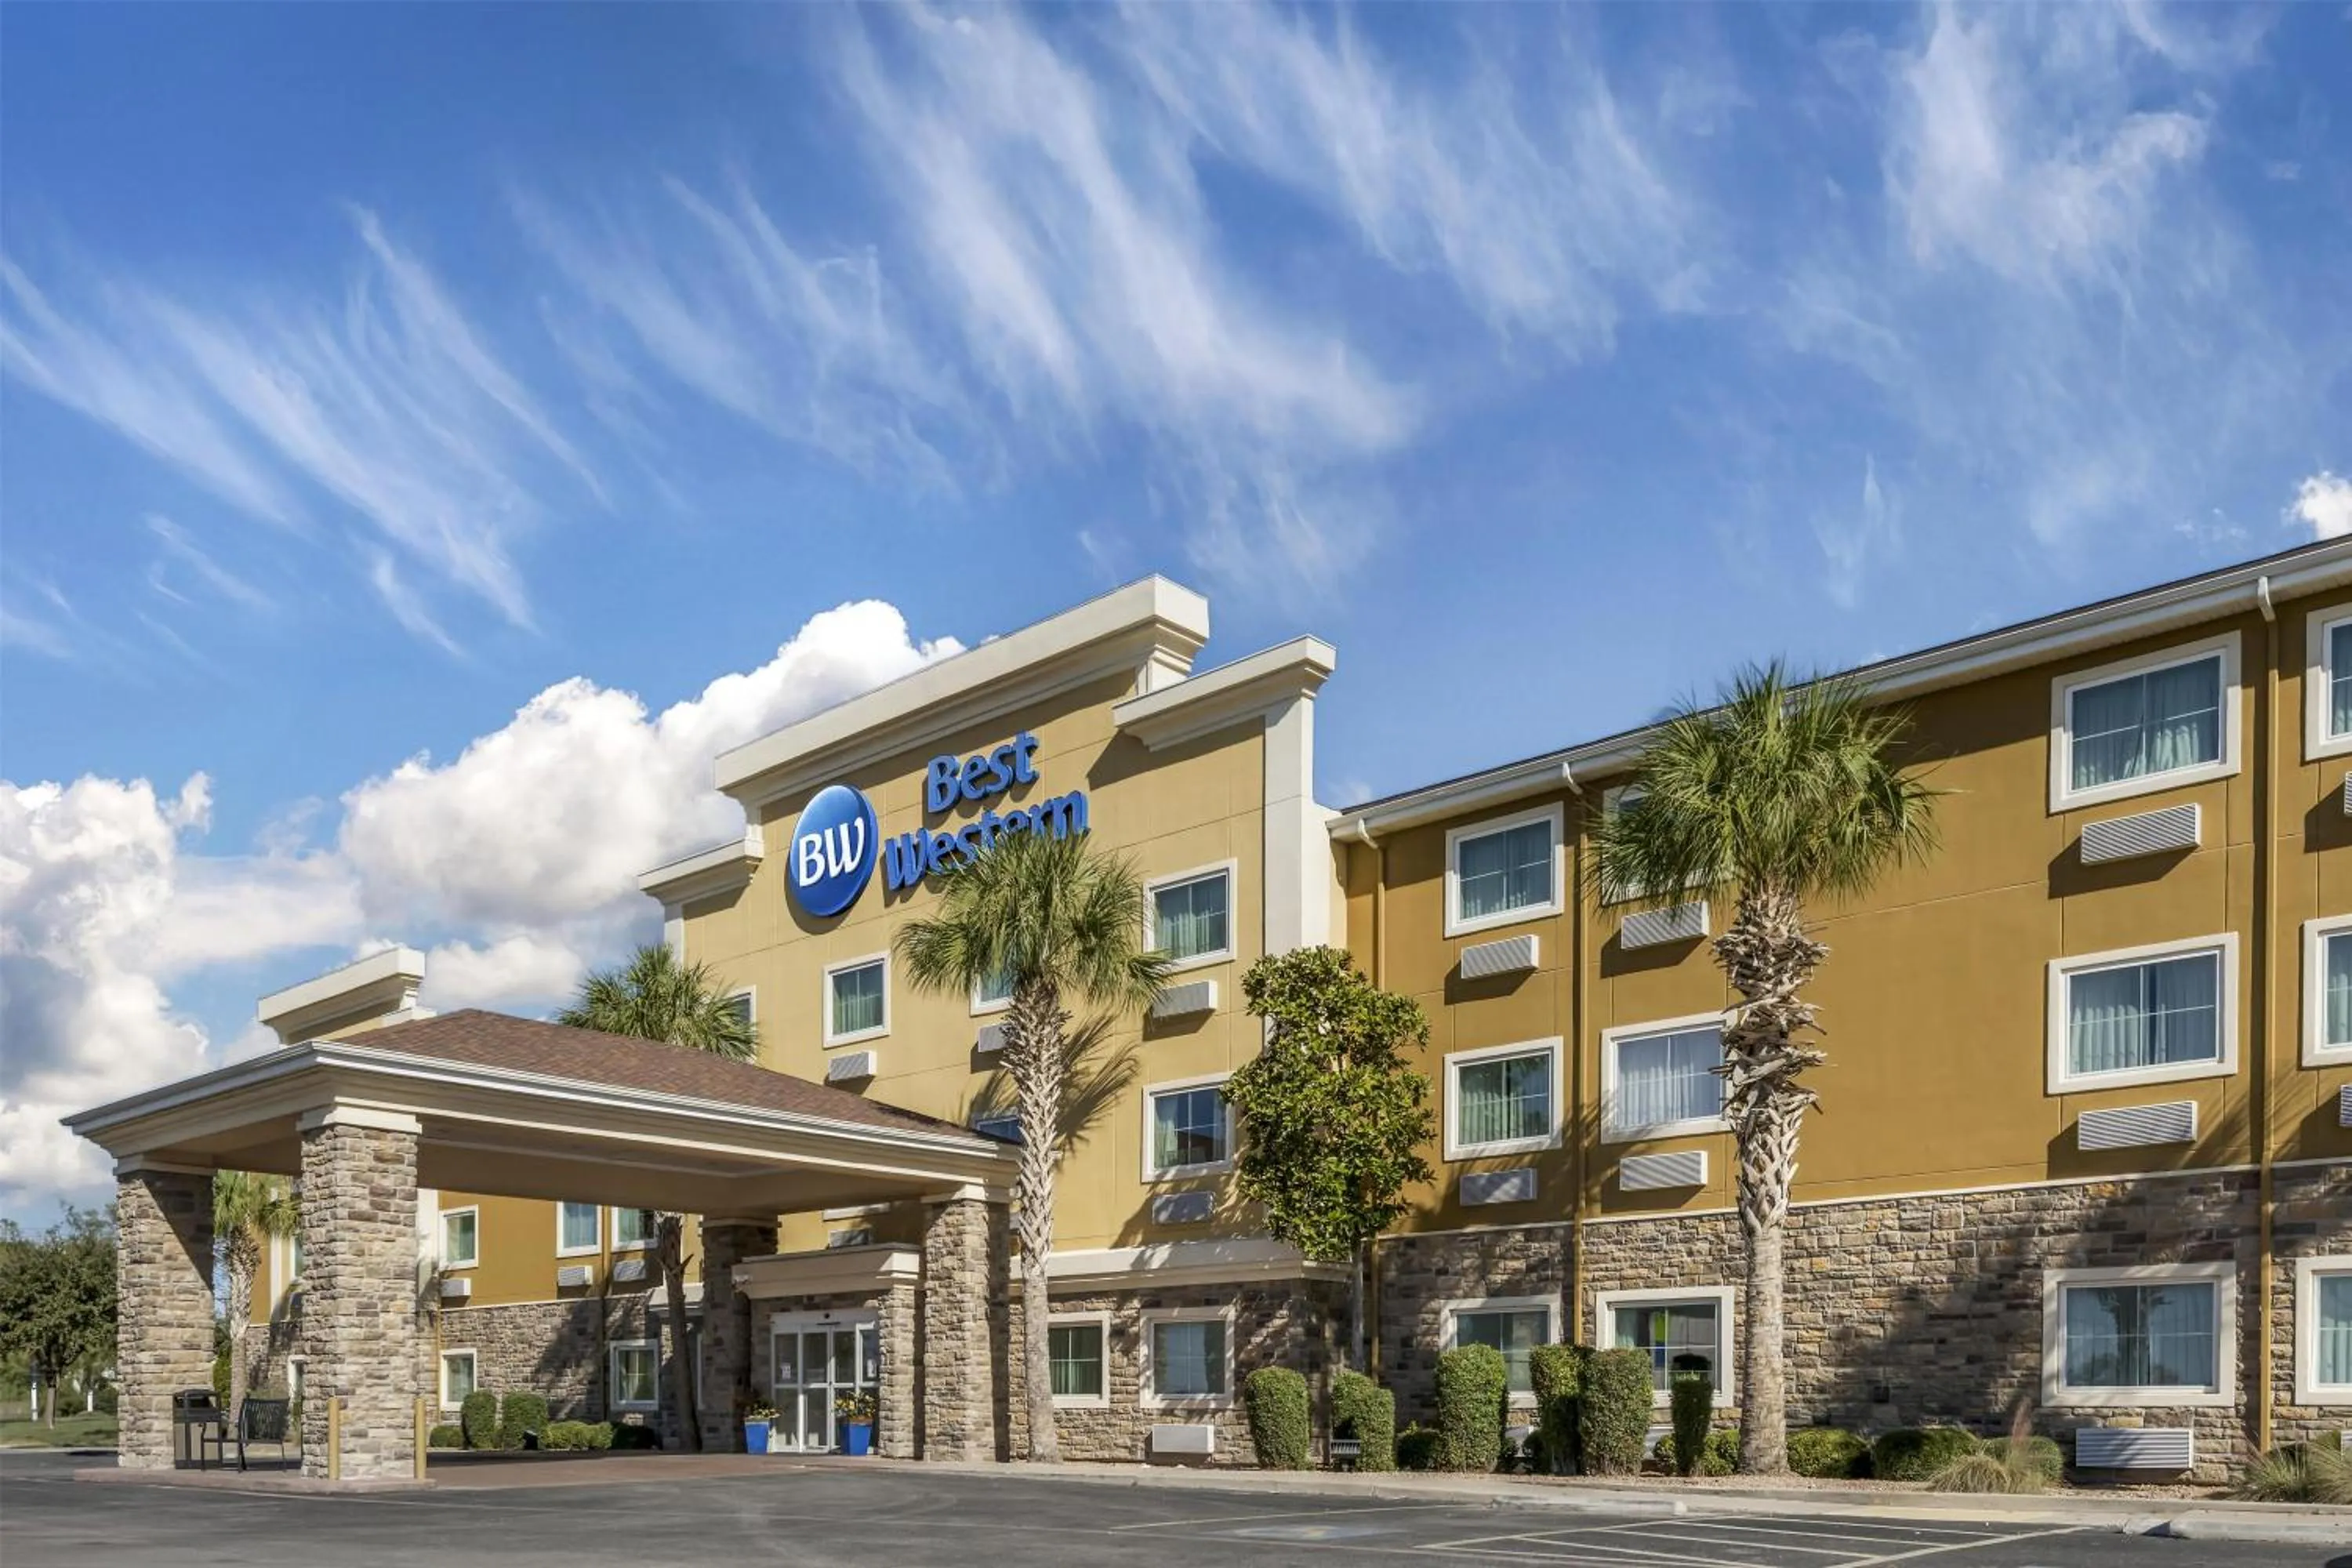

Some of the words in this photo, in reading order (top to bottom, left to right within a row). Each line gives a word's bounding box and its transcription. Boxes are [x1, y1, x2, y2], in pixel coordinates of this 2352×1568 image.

[927, 731, 1040, 814] Best
[799, 816, 865, 887] BW
[884, 790, 1089, 891] Western
